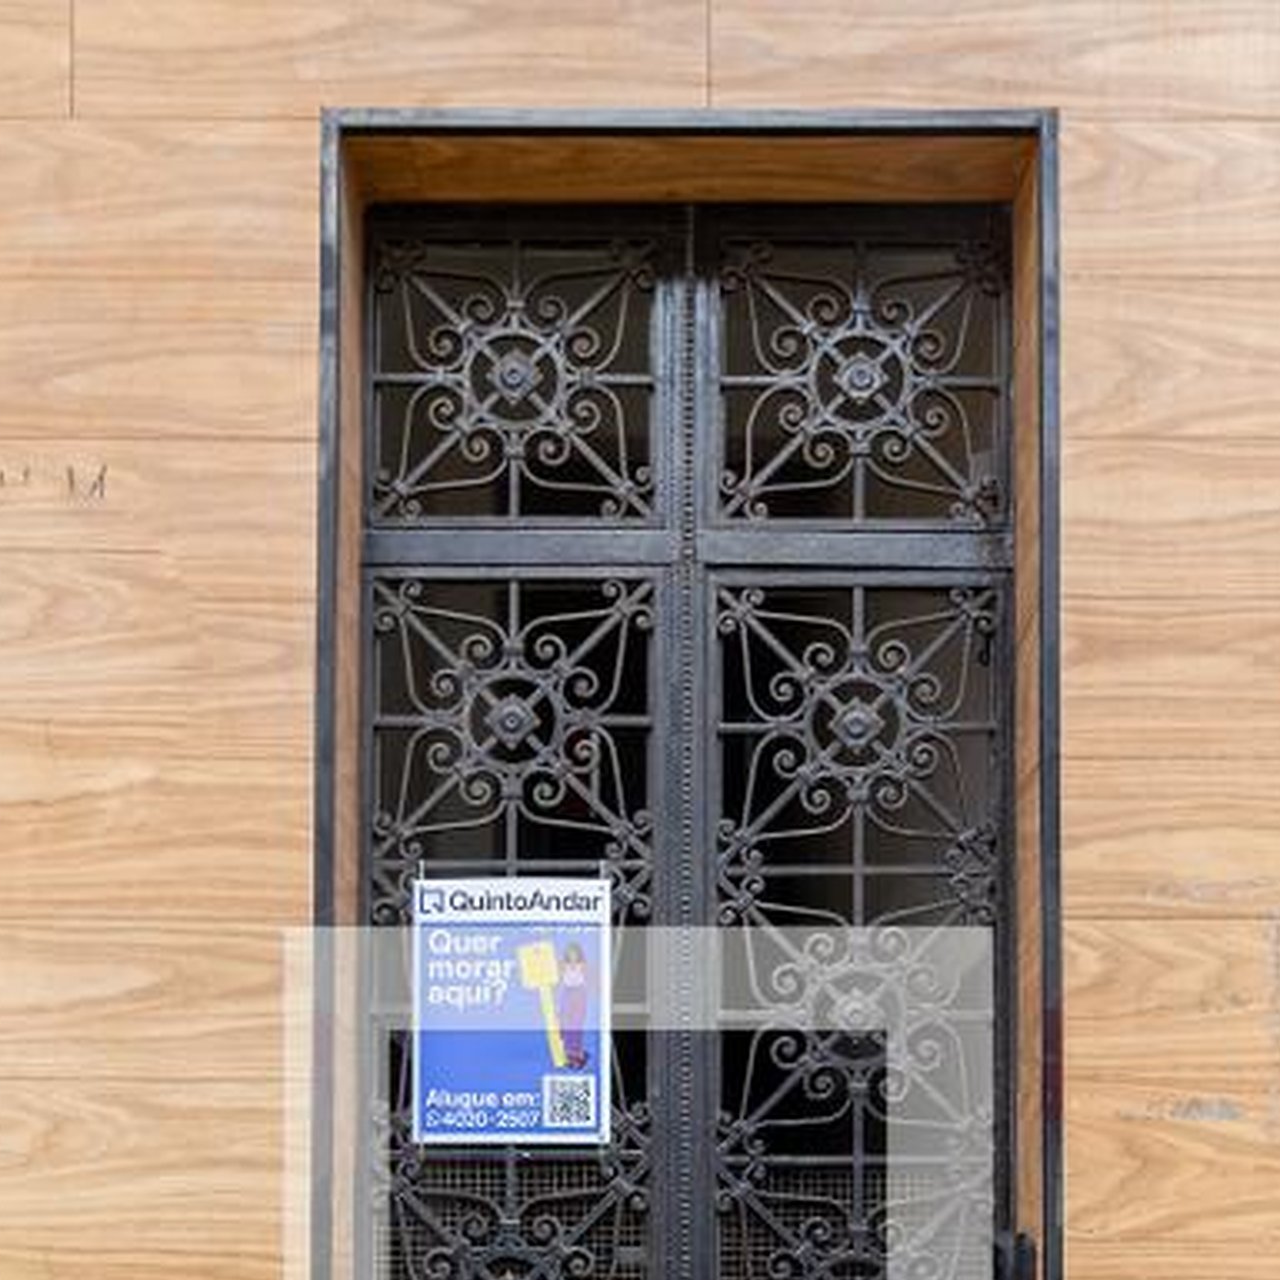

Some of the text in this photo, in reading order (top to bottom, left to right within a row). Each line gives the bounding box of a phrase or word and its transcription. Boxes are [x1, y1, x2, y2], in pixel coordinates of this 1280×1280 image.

[449, 888, 601, 912] QuintoAndar
[427, 929, 502, 956] Quer
[427, 959, 516, 981] morar
[427, 977, 508, 1007] aqui?
[425, 1088, 499, 1112] Alugue
